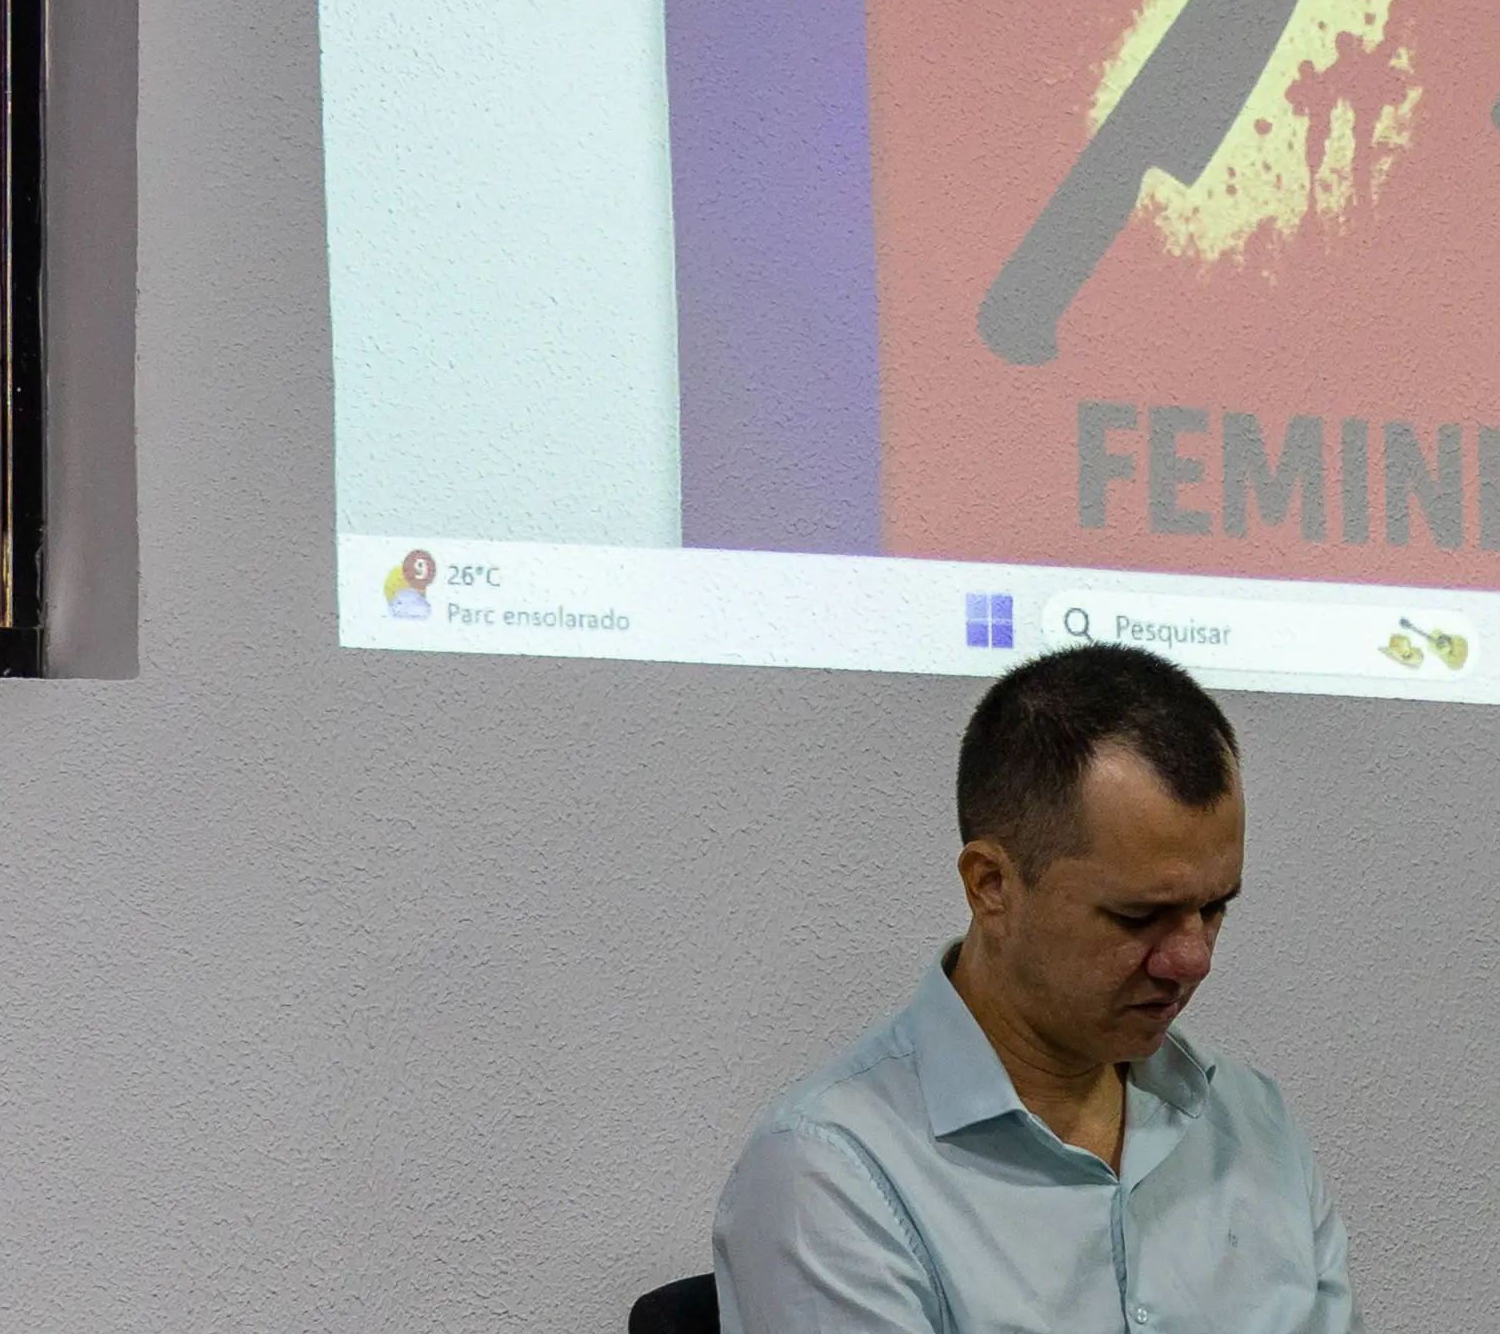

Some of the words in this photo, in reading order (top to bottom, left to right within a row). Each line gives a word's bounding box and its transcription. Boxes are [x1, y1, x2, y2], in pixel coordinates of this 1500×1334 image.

[414, 558, 429, 580] 9
[447, 565, 501, 587] 26°C
[447, 602, 496, 626] Parc
[503, 604, 631, 631] ensolarado
[1114, 613, 1232, 651] Pesquisar
